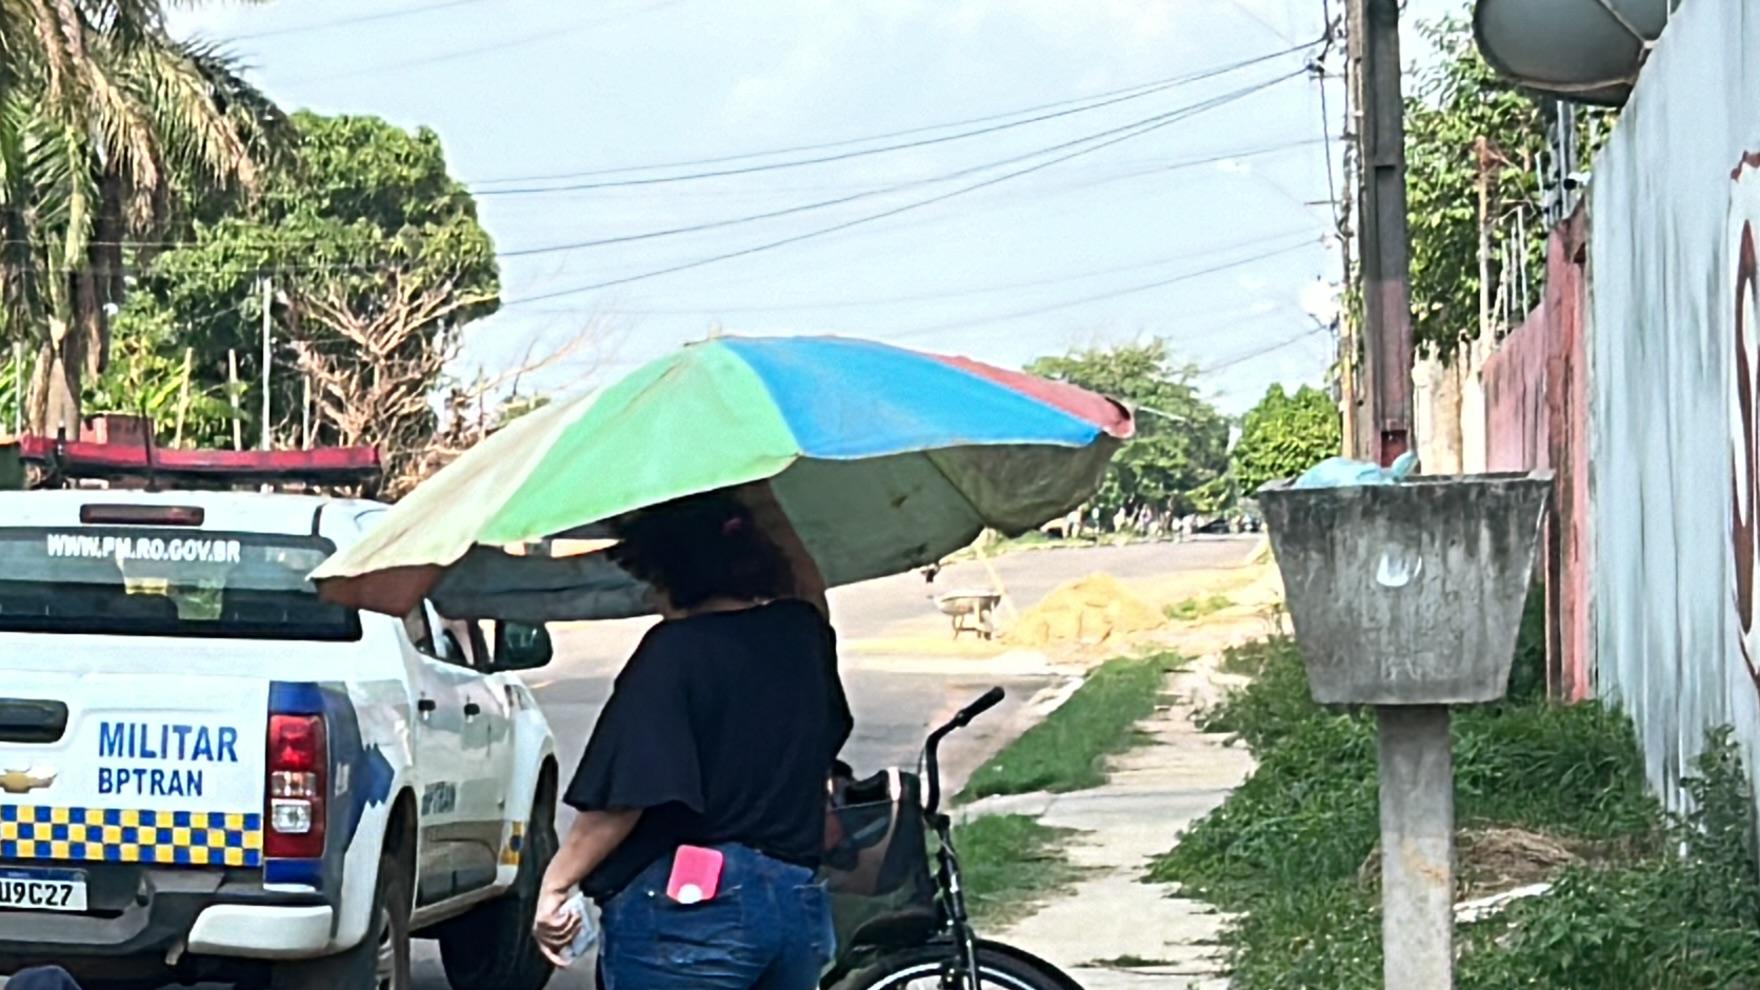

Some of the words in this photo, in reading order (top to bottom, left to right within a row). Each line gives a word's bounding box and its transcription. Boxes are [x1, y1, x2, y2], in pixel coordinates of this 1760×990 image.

[47, 534, 241, 563] WWW.PM.RO.GOV.BR
[99, 722, 238, 762] MILITAR
[99, 767, 202, 796] BPTRAN
